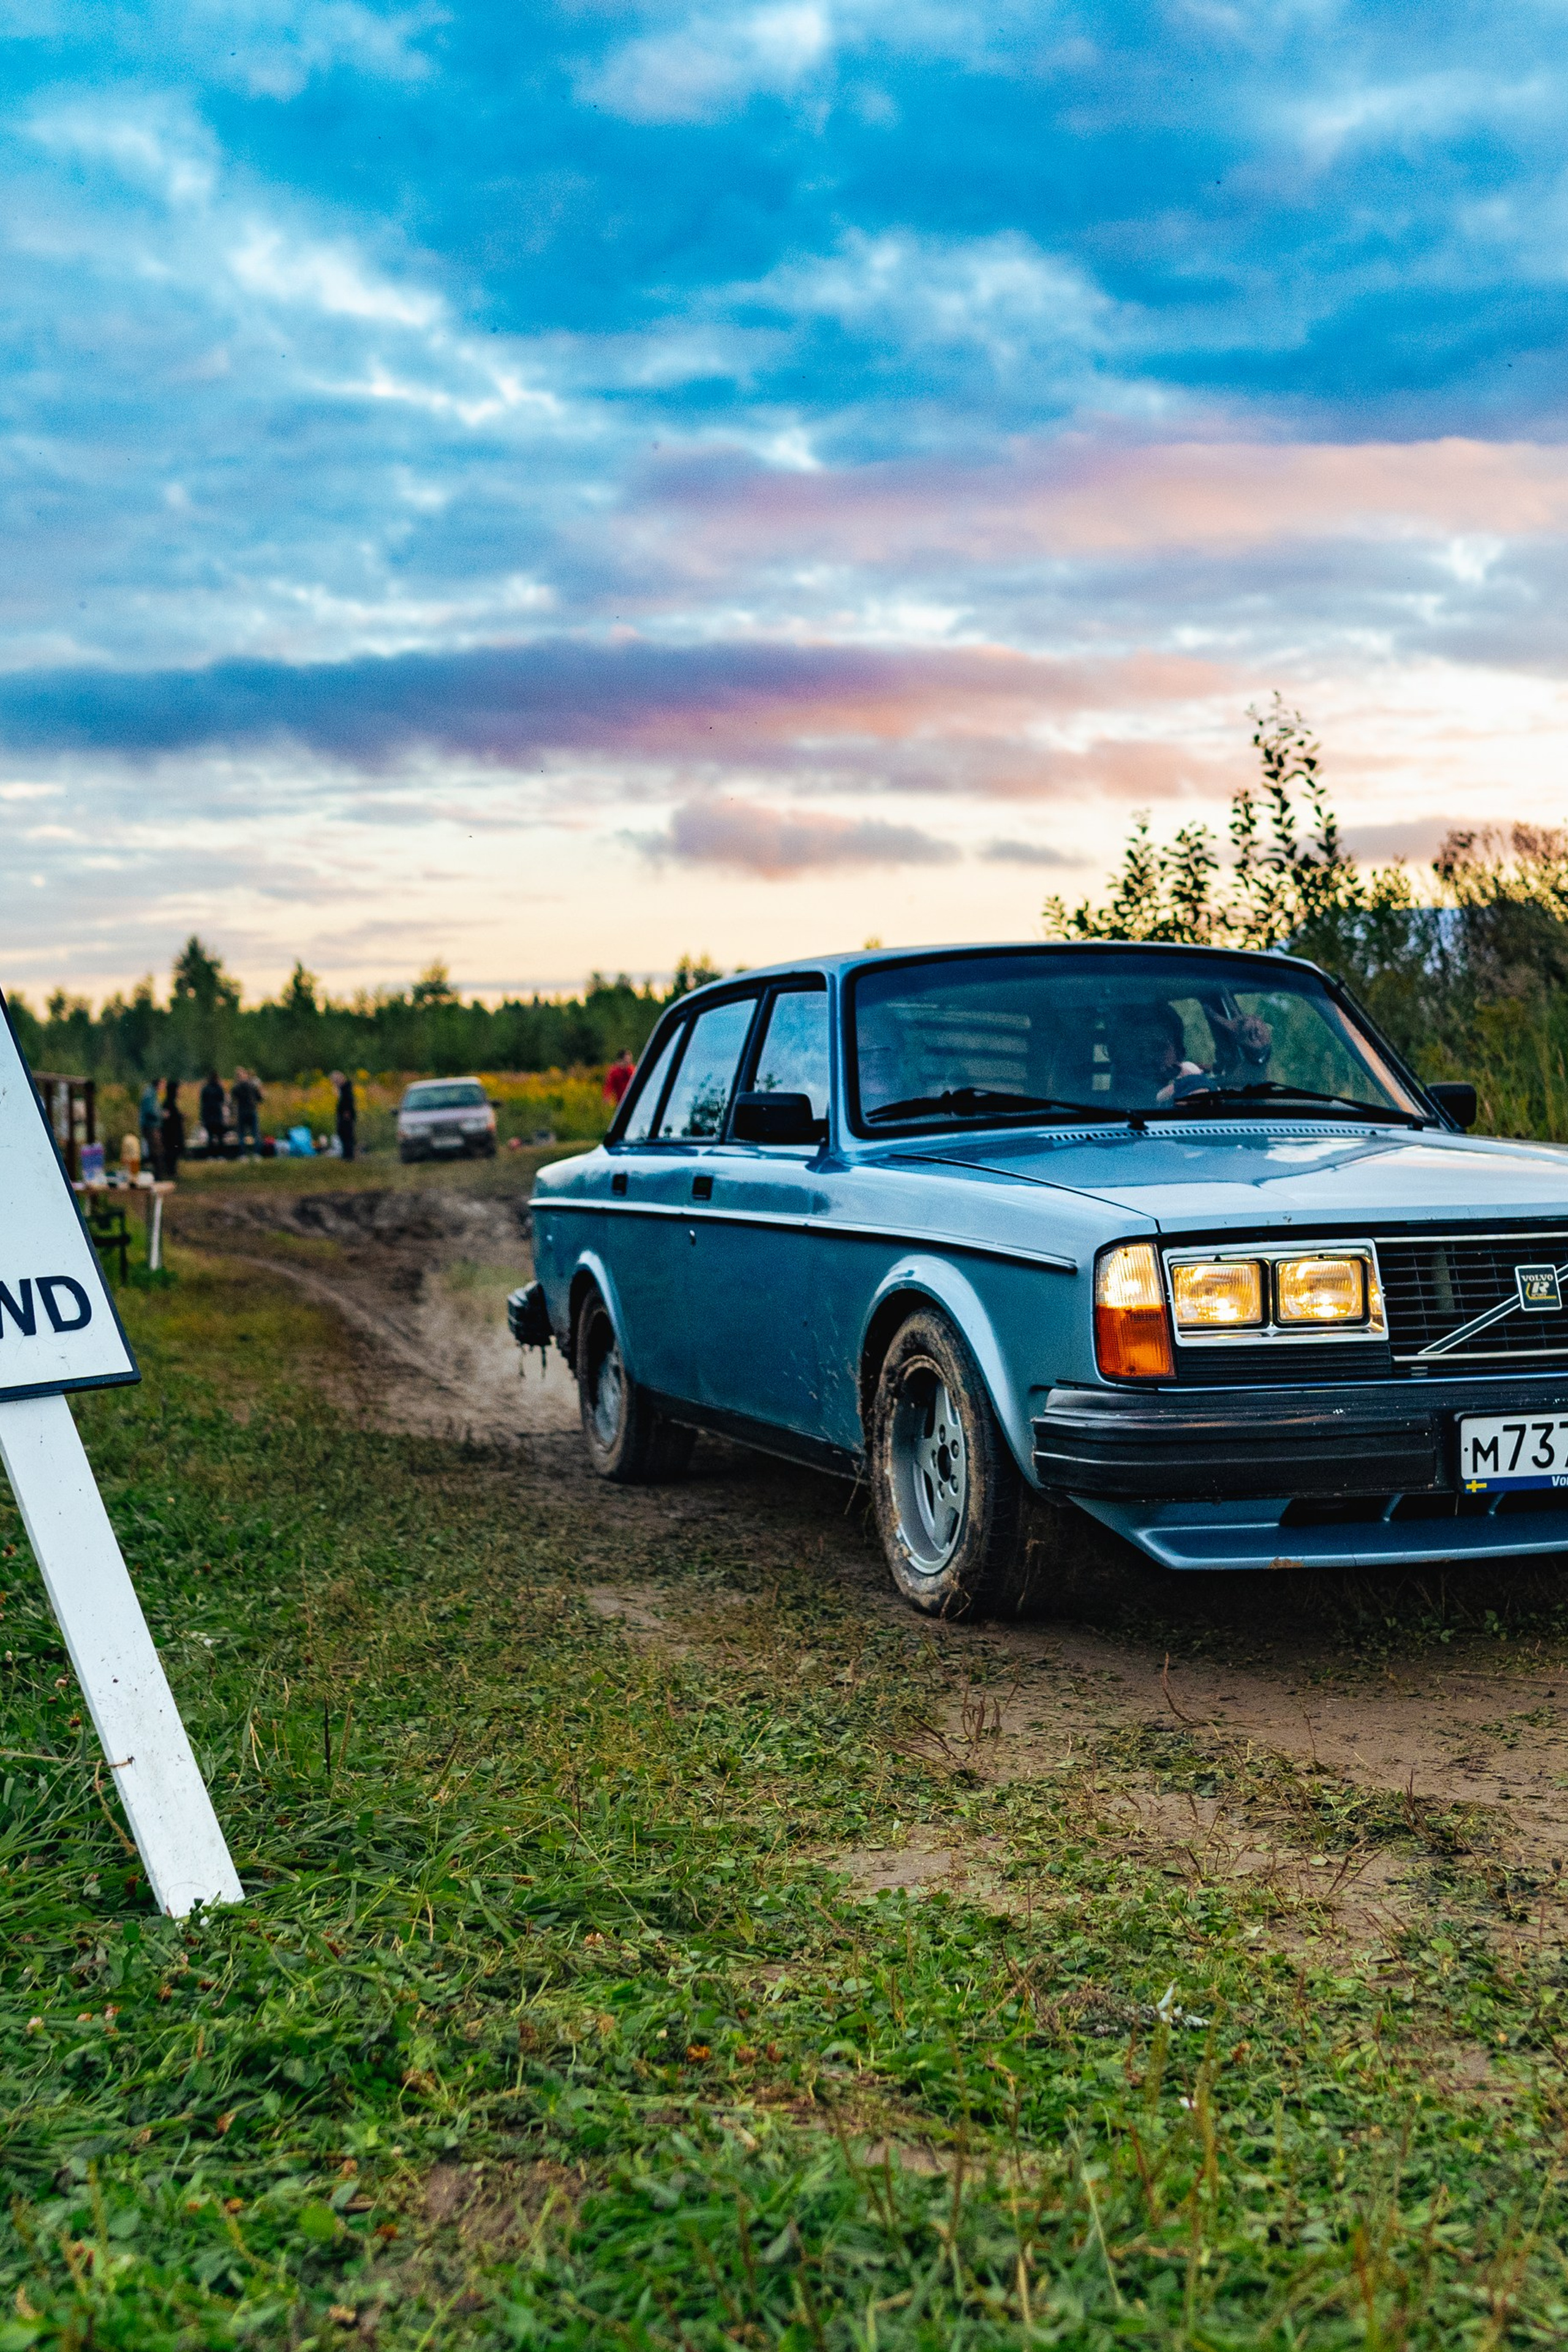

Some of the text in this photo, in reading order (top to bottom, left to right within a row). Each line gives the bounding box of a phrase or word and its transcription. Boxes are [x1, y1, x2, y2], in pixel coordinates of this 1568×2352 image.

[1532, 1281, 1550, 1294] R
[0, 1275, 92, 1339] ND
[1551, 1475, 1568, 1487] Vo
